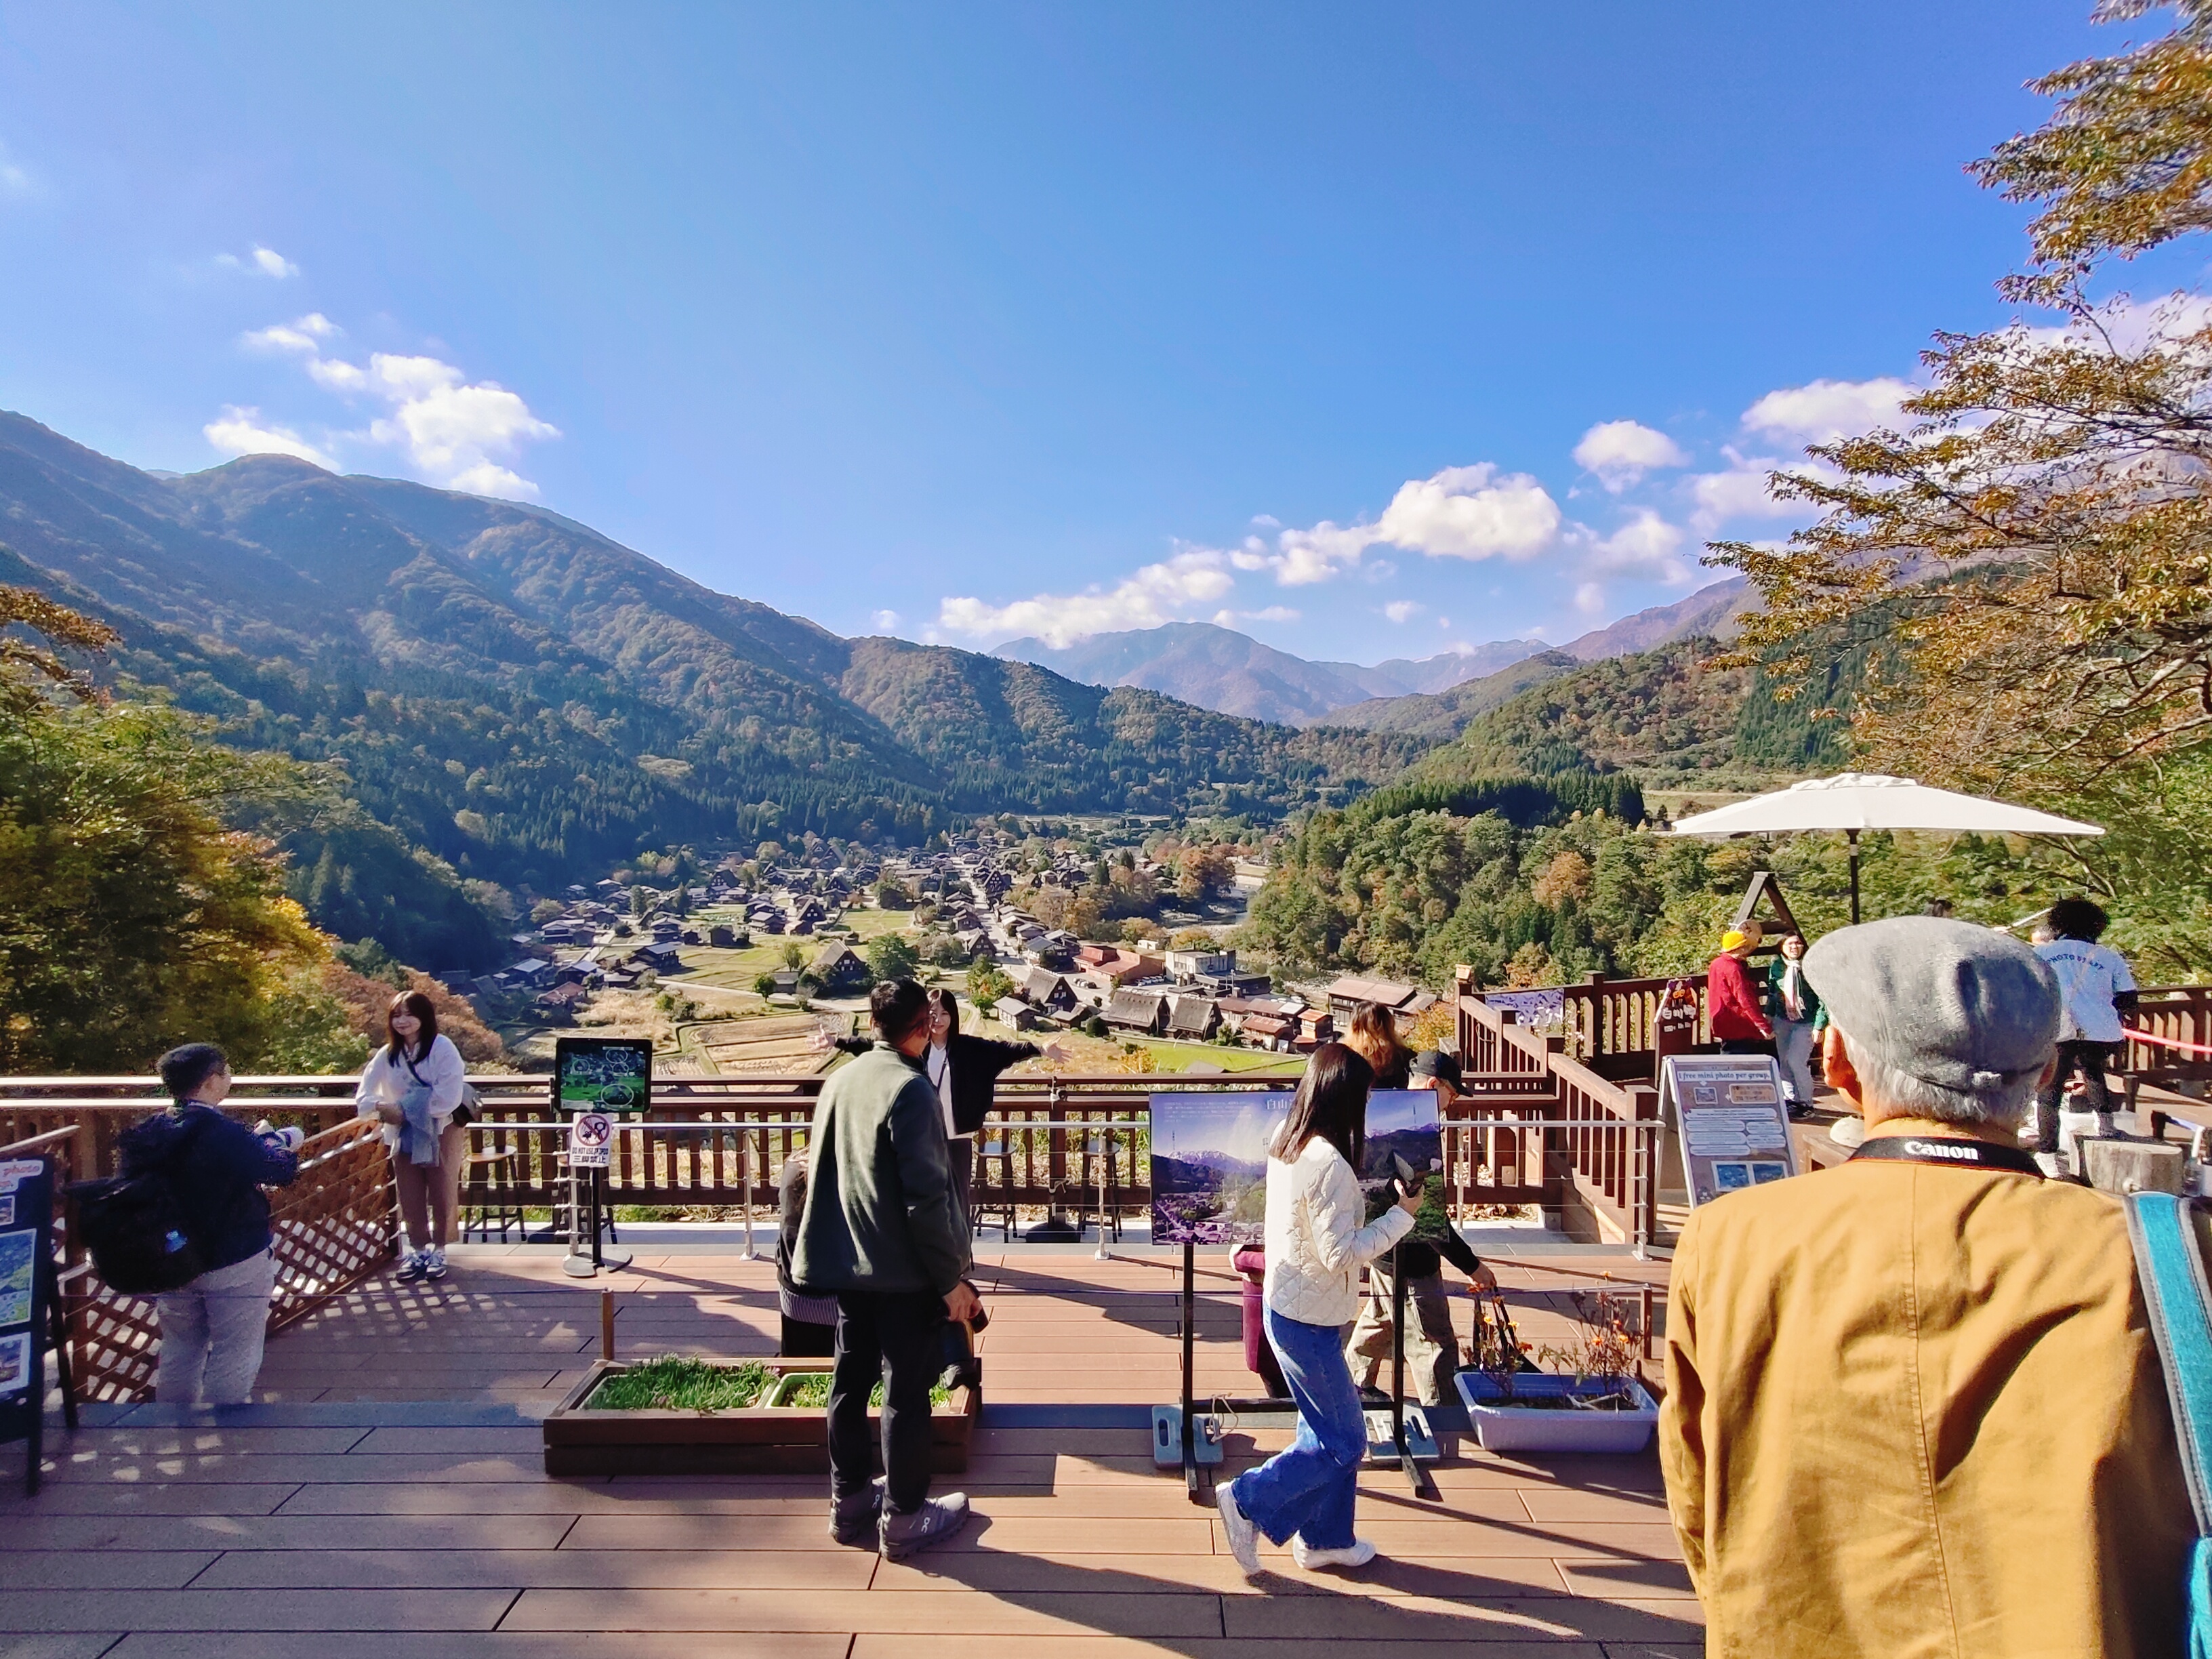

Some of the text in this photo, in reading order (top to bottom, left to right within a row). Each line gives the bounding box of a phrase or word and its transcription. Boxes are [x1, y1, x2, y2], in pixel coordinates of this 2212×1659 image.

[1683, 1072, 1696, 1080] free
[1715, 1072, 1735, 1080] photo
[1736, 1072, 1746, 1080] per
[1904, 1141, 1979, 1160] Canon
